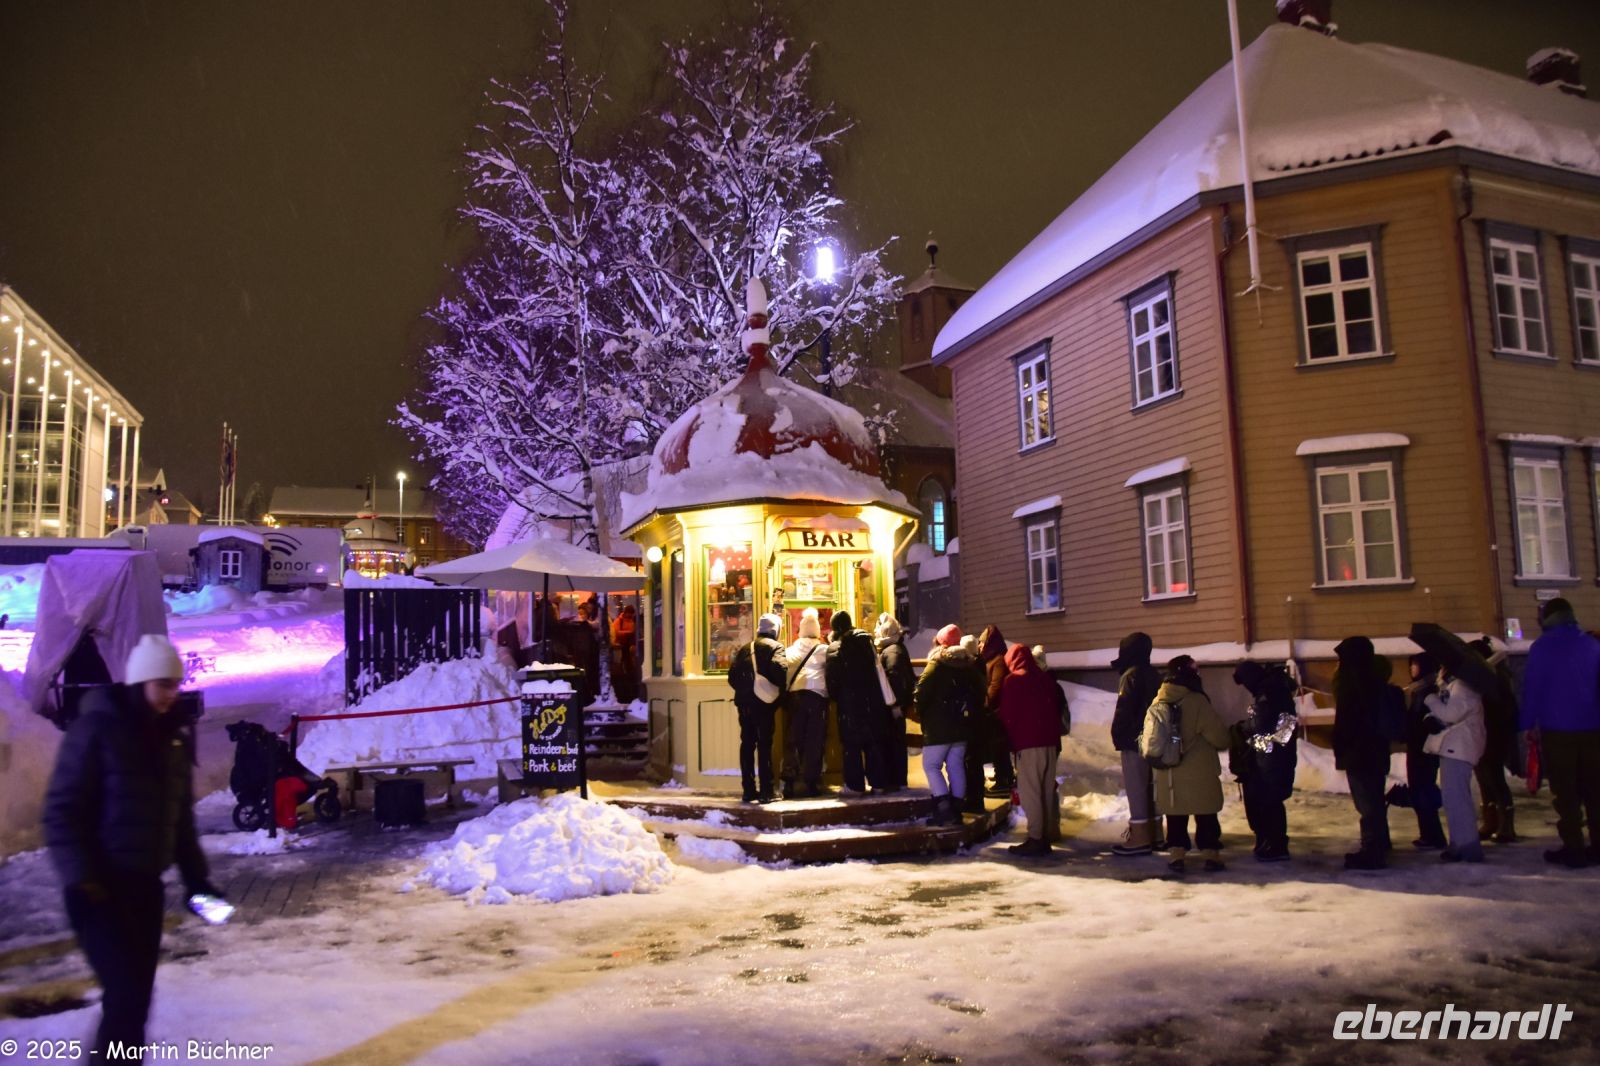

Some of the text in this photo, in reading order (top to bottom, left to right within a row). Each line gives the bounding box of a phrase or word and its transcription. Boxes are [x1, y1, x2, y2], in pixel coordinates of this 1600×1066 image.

[802, 531, 855, 547] BAR
[529, 741, 562, 755] Reindeer
[529, 758, 550, 772] Pork
[558, 759, 577, 772] beef
